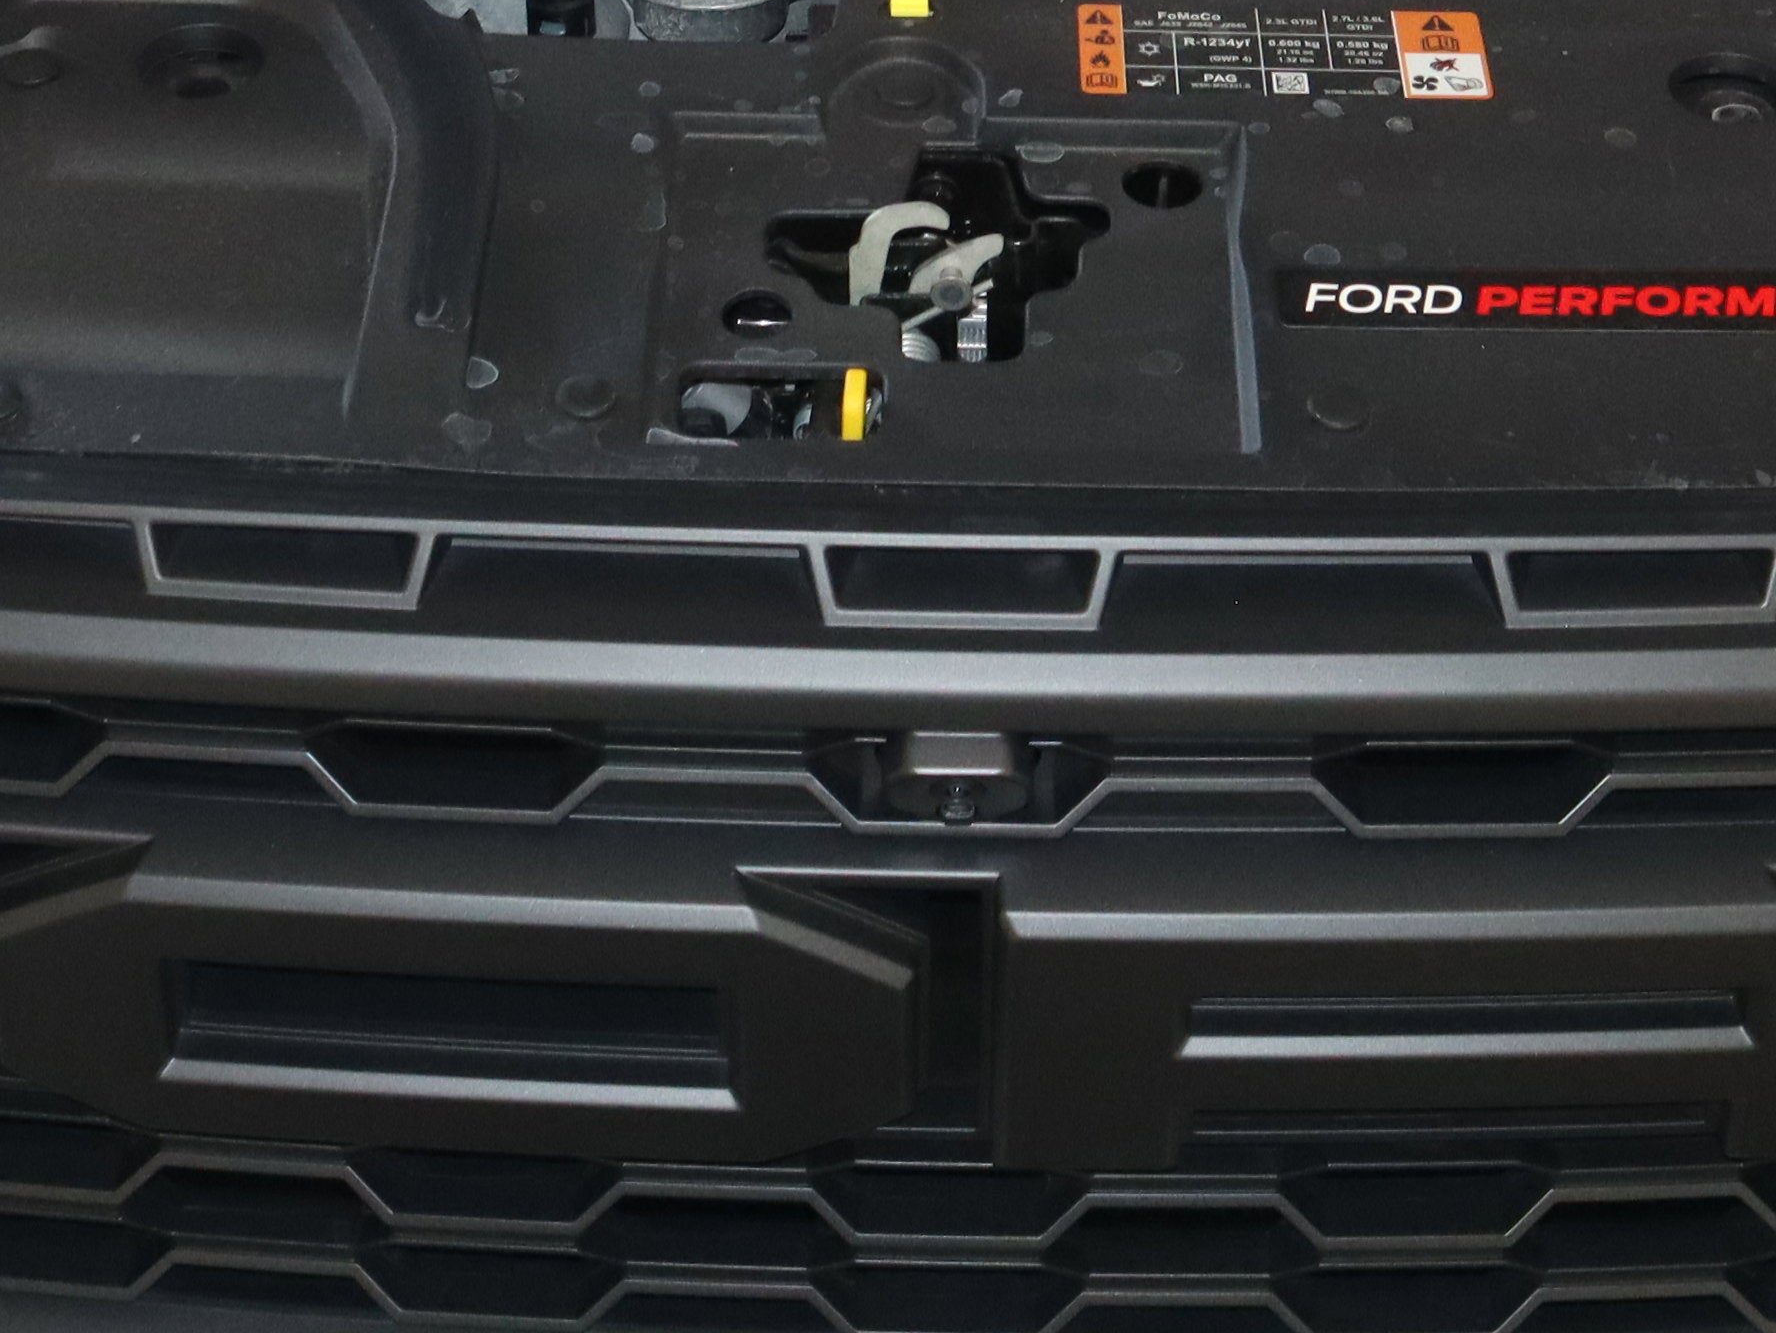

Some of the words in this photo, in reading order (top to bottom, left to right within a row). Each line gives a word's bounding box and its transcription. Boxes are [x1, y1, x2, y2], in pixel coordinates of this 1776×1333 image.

[1157, 11, 1221, 21] FoMoCo
[1184, 37, 1250, 49] R-1234yf
[1304, 39, 1320, 49] kg
[1372, 41, 1389, 50] kg
[1209, 55, 1240, 63] (GWP
[1242, 55, 1253, 64] 4)
[1203, 73, 1238, 82] PAG
[1305, 283, 1463, 314] FORD
